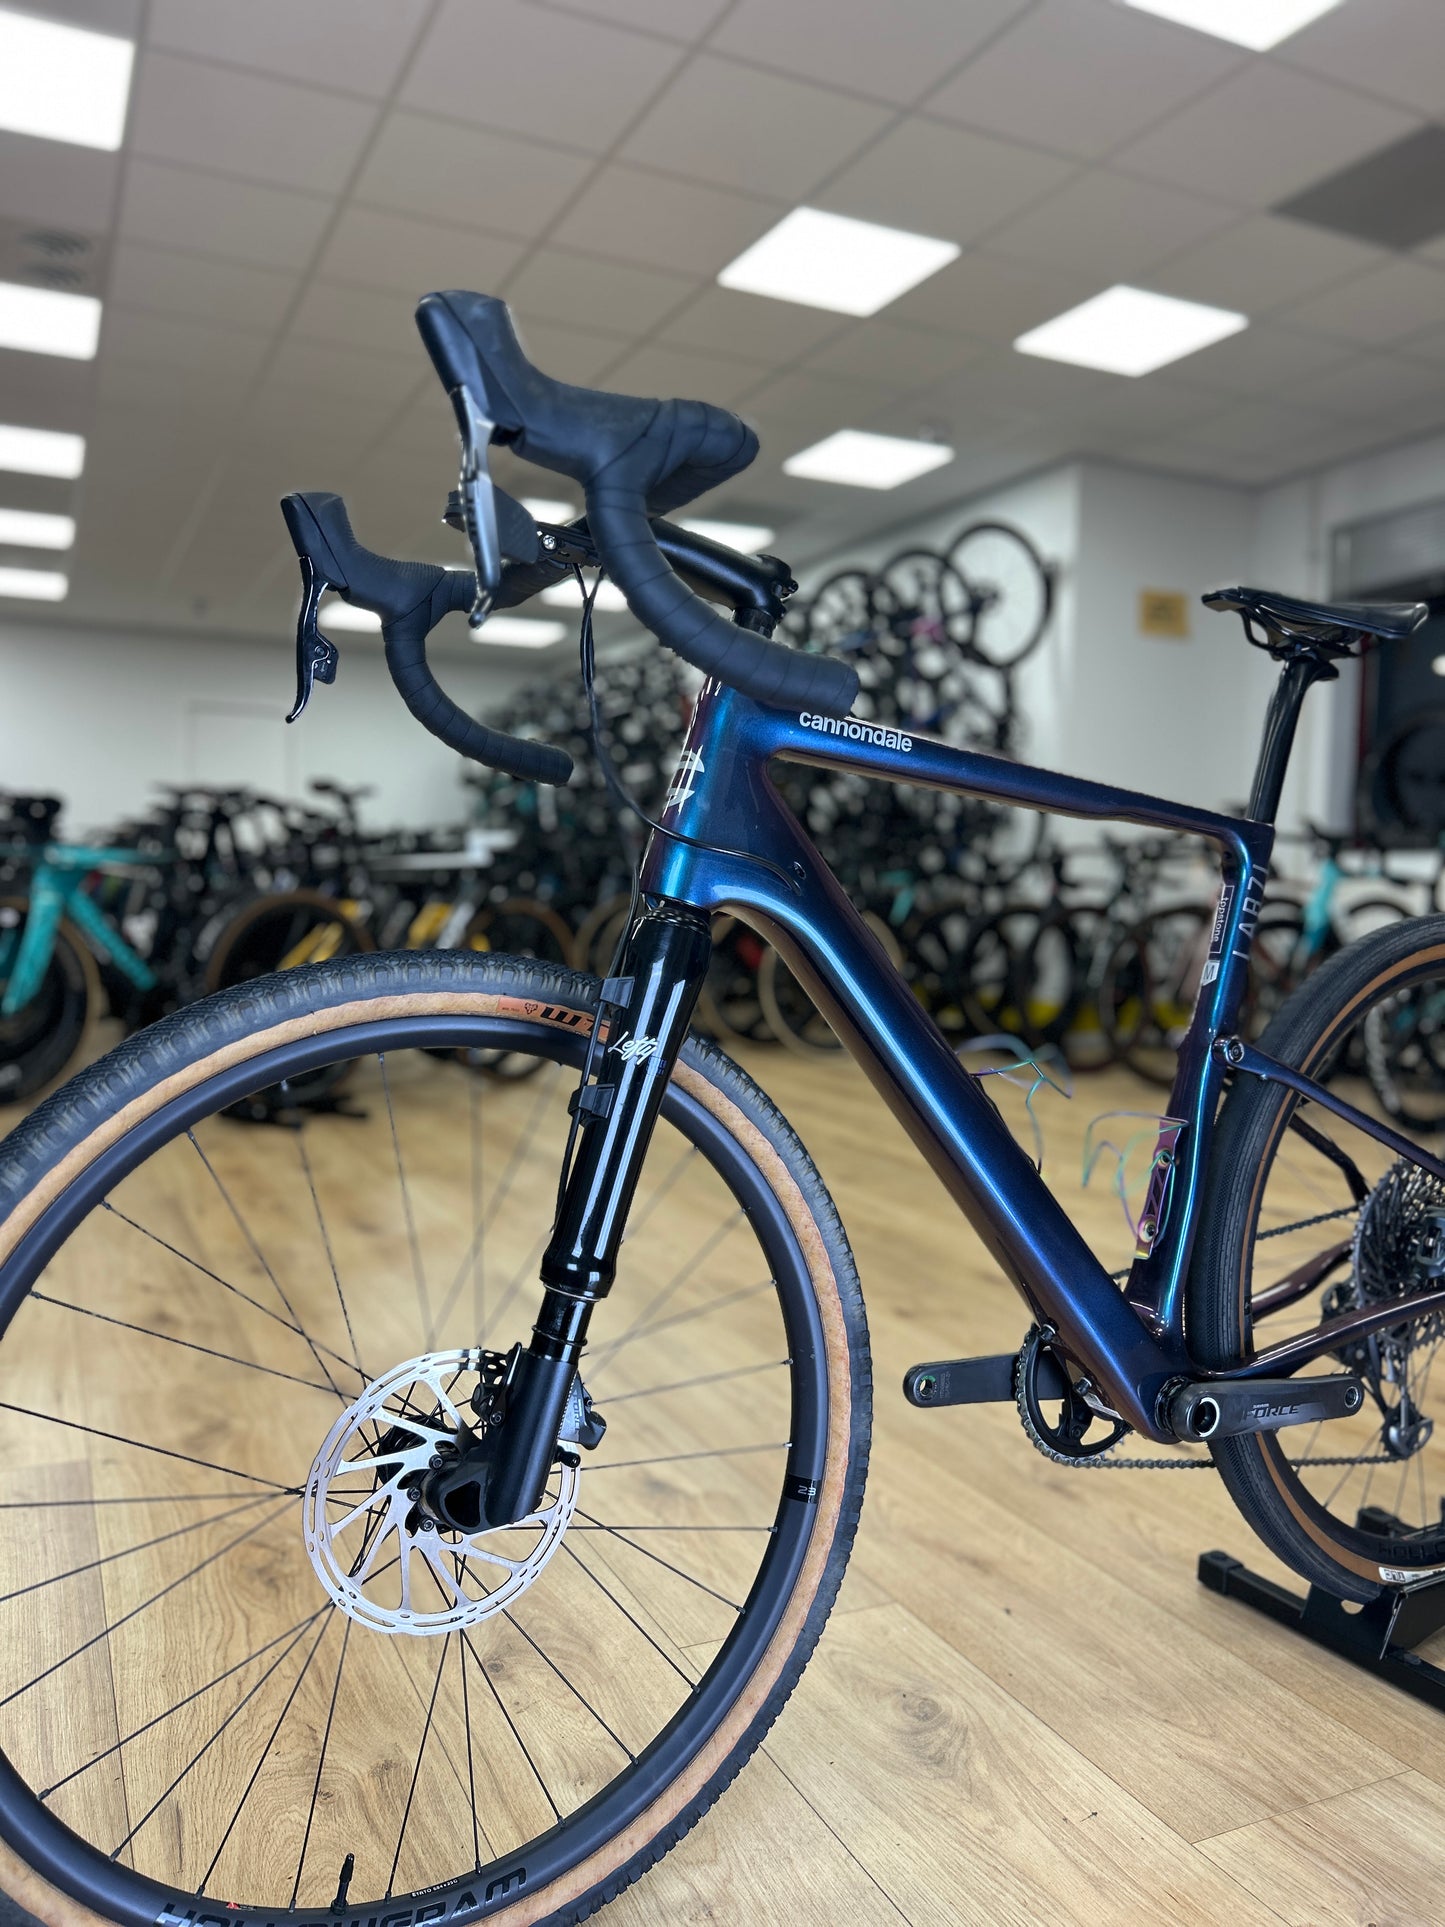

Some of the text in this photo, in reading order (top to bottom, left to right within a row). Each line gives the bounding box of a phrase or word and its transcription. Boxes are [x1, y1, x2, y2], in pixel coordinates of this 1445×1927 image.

[799, 711, 913, 752] cannondale
[1212, 896, 1229, 942] topstone
[607, 1031, 659, 1065] Lefty
[1241, 1404, 1300, 1421] FORCE
[153, 1867, 527, 1927] HOGRAM
